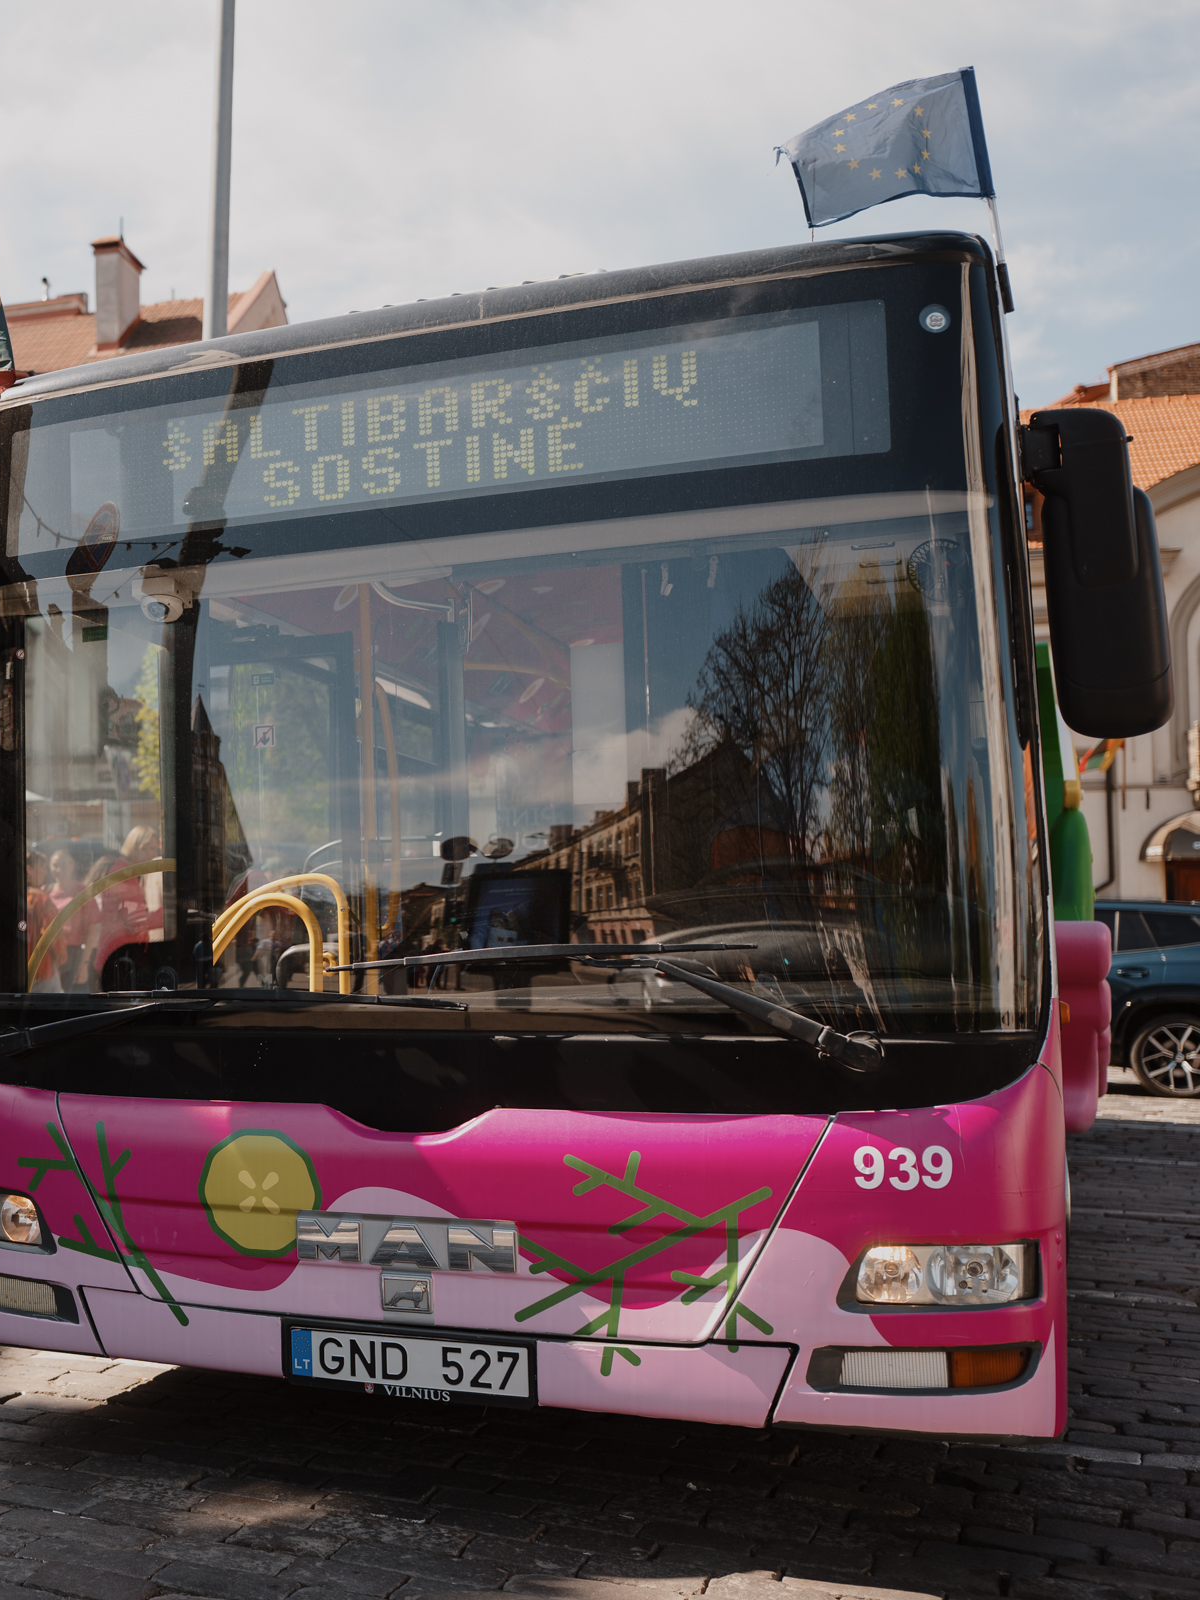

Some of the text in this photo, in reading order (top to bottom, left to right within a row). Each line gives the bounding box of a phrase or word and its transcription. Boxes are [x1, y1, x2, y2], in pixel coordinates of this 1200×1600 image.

[162, 350, 698, 471] ŠALTIBARŠČIŲ
[263, 417, 584, 507] SOSTINĖ
[853, 1145, 953, 1191] 939
[296, 1217, 518, 1273] MAN
[294, 1337, 520, 1391] LT GND 527
[383, 1384, 451, 1402] VILNIUS
